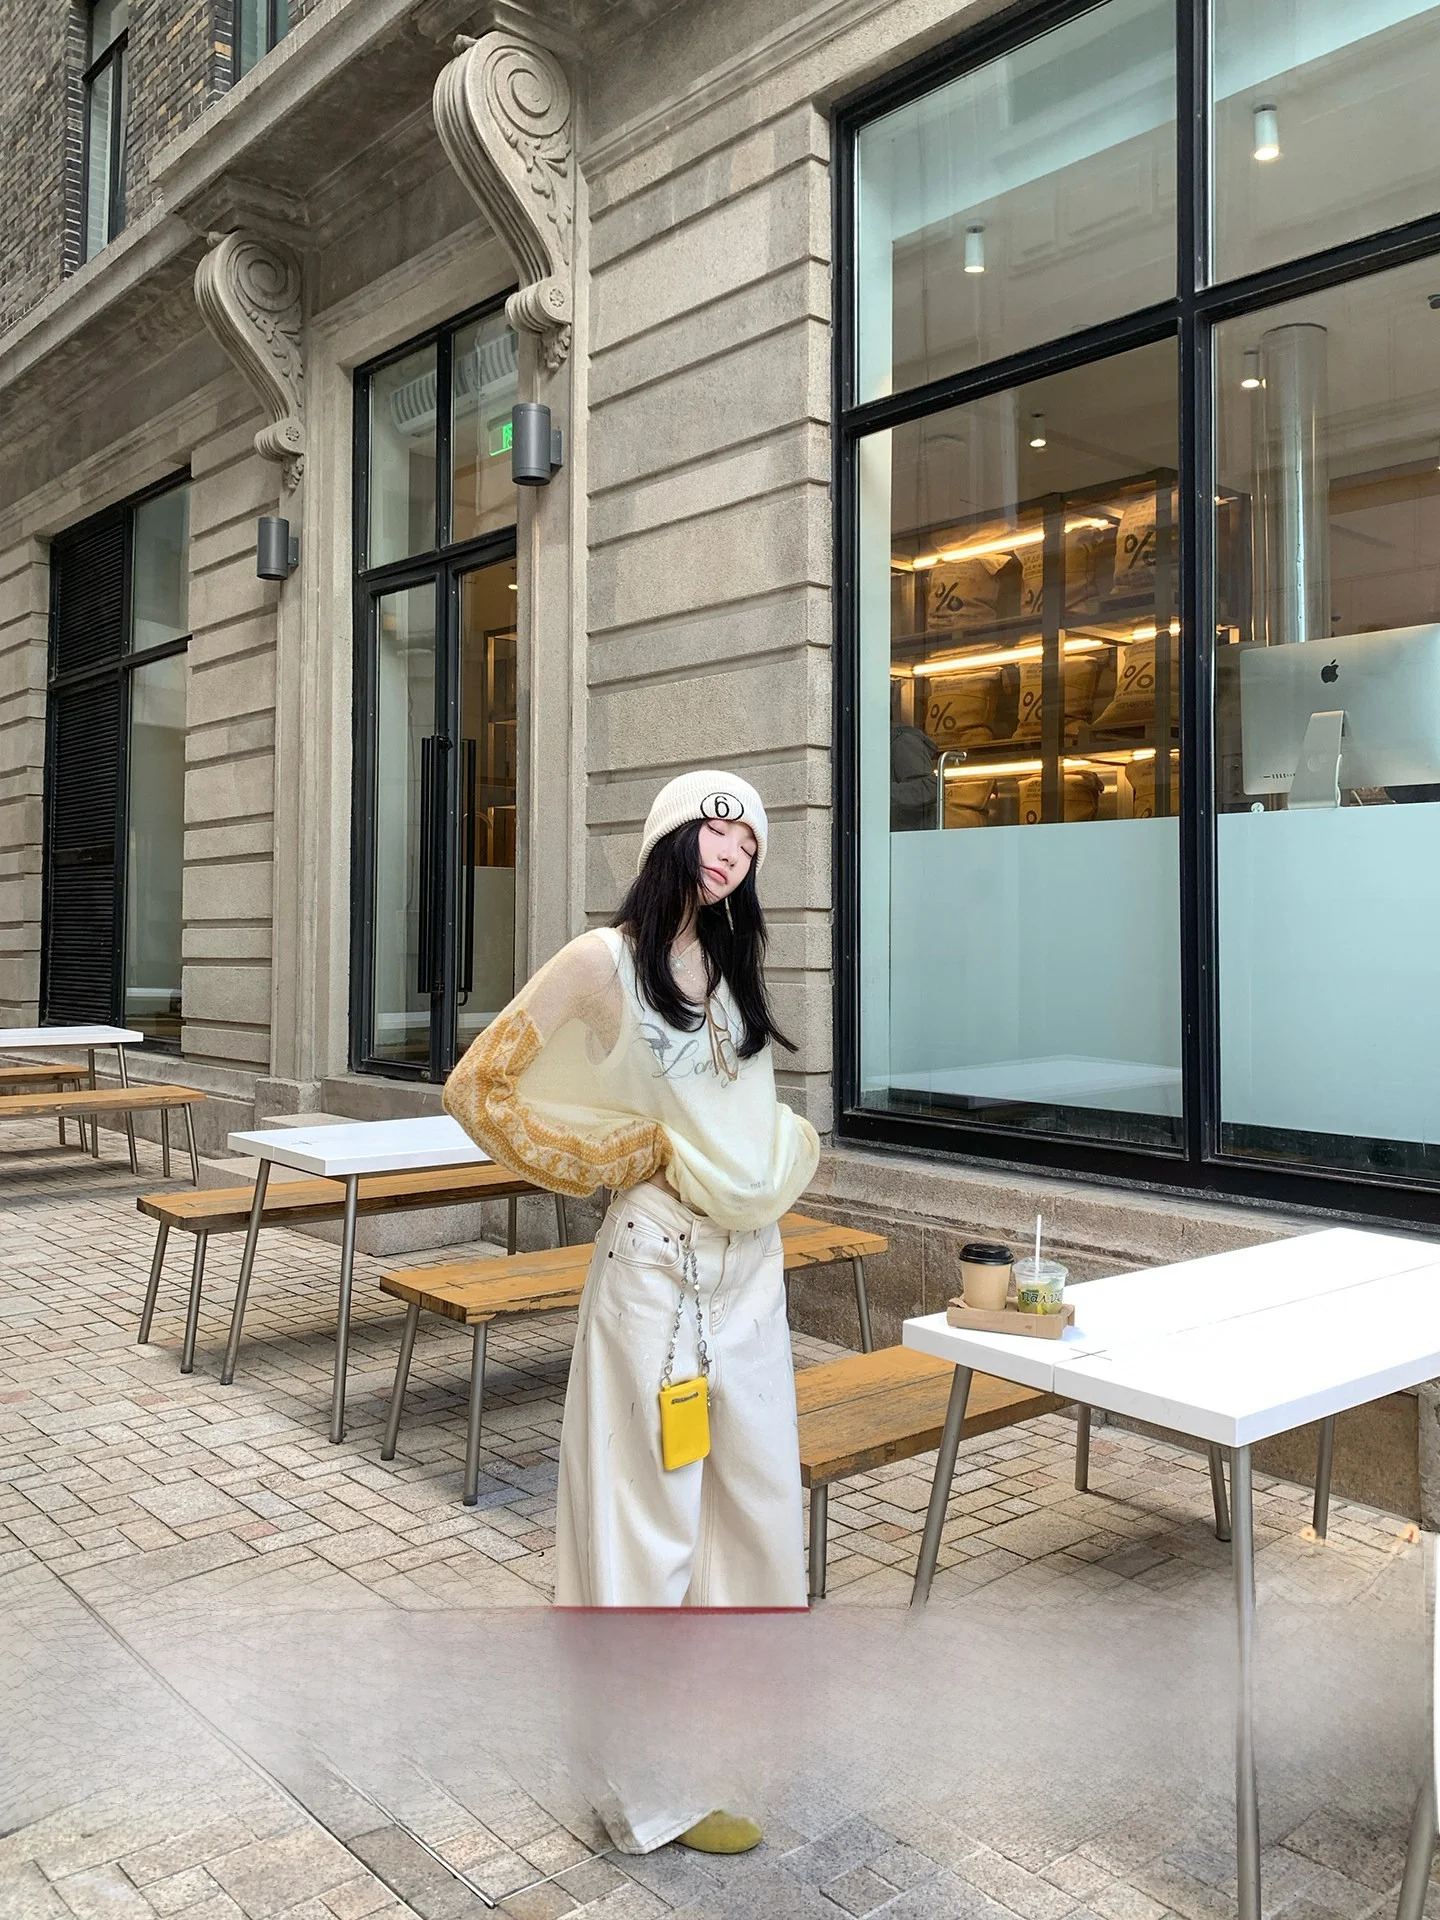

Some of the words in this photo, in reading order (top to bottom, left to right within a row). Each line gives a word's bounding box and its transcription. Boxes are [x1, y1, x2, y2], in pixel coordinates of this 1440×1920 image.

[1123, 530, 1158, 570] %
[934, 581, 965, 613] %
[1123, 660, 1155, 691] %
[930, 701, 957, 733] %
[714, 795, 730, 818] 6
